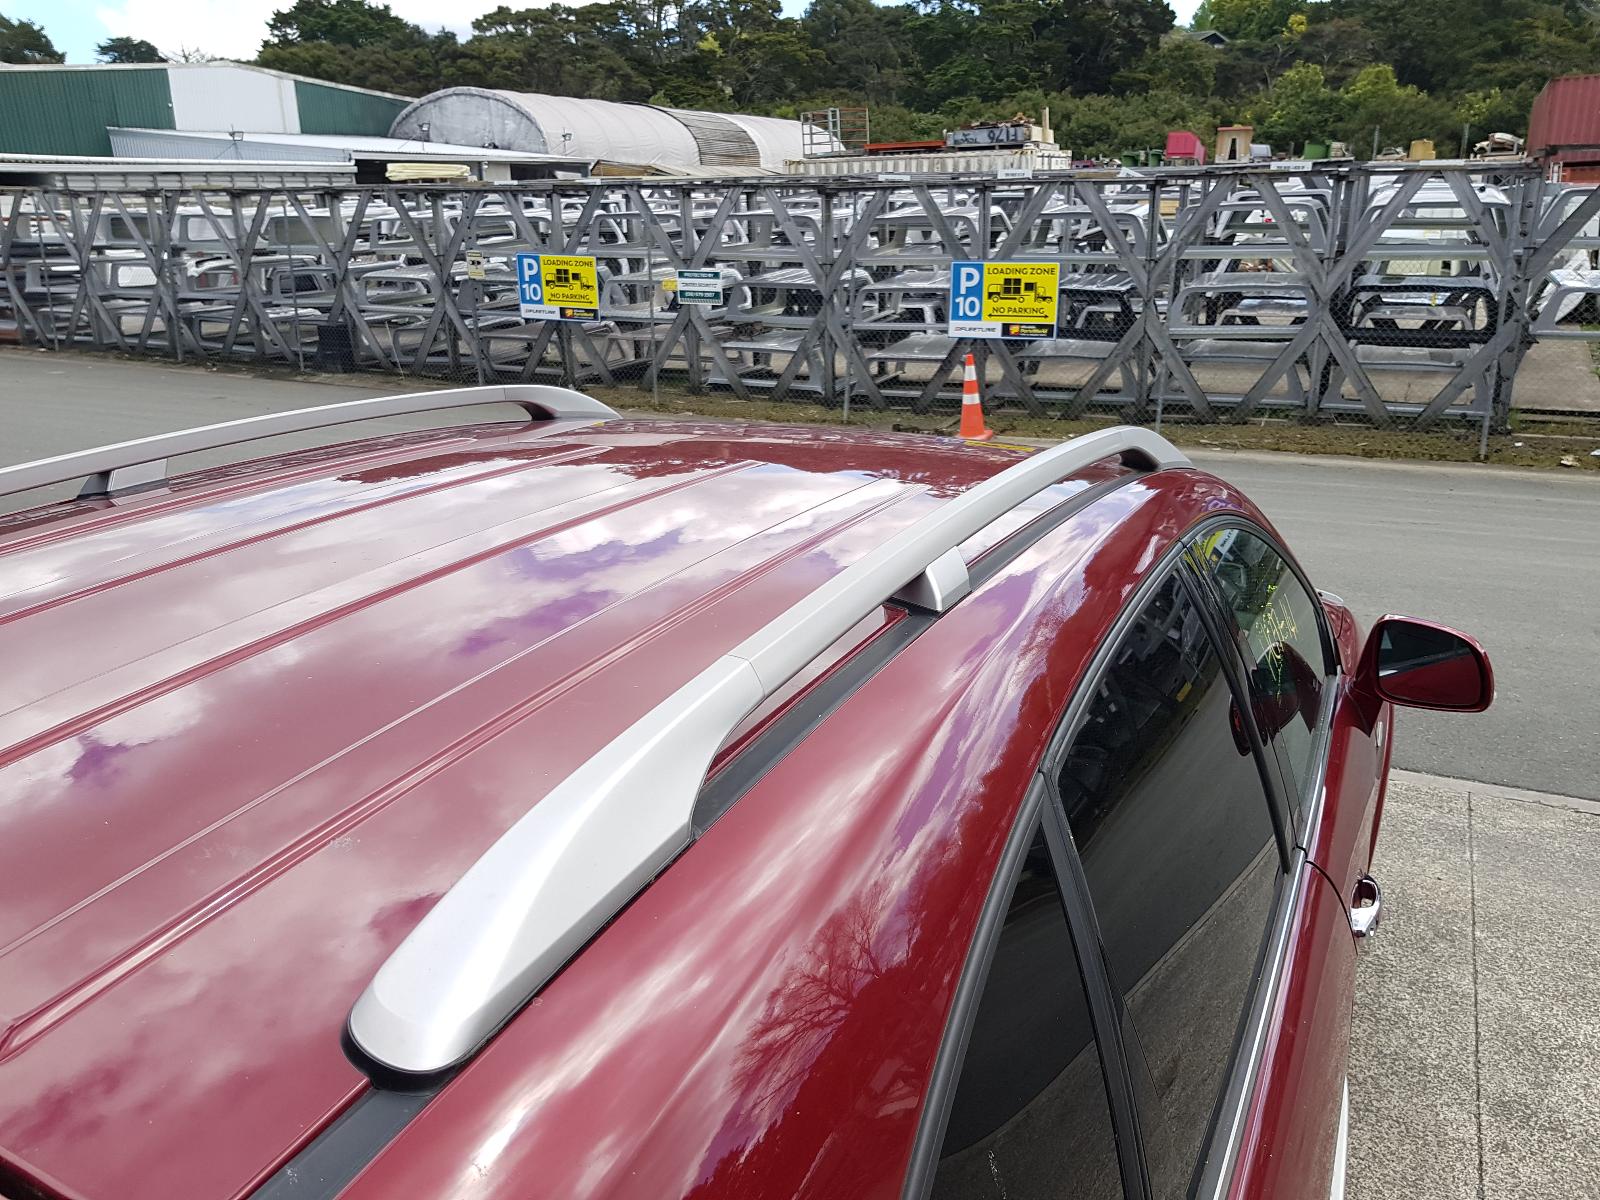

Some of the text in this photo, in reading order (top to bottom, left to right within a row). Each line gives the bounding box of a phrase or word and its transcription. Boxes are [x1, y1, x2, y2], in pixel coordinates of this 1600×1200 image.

[523, 258, 538, 282] P
[543, 259, 594, 268] LOADING ZONE
[987, 267, 1028, 275] LOADING
[960, 267, 980, 294] P
[521, 283, 542, 301] 10
[561, 293, 590, 301] PARKING
[955, 296, 980, 317] 10
[1007, 307, 1045, 315] PARKING
